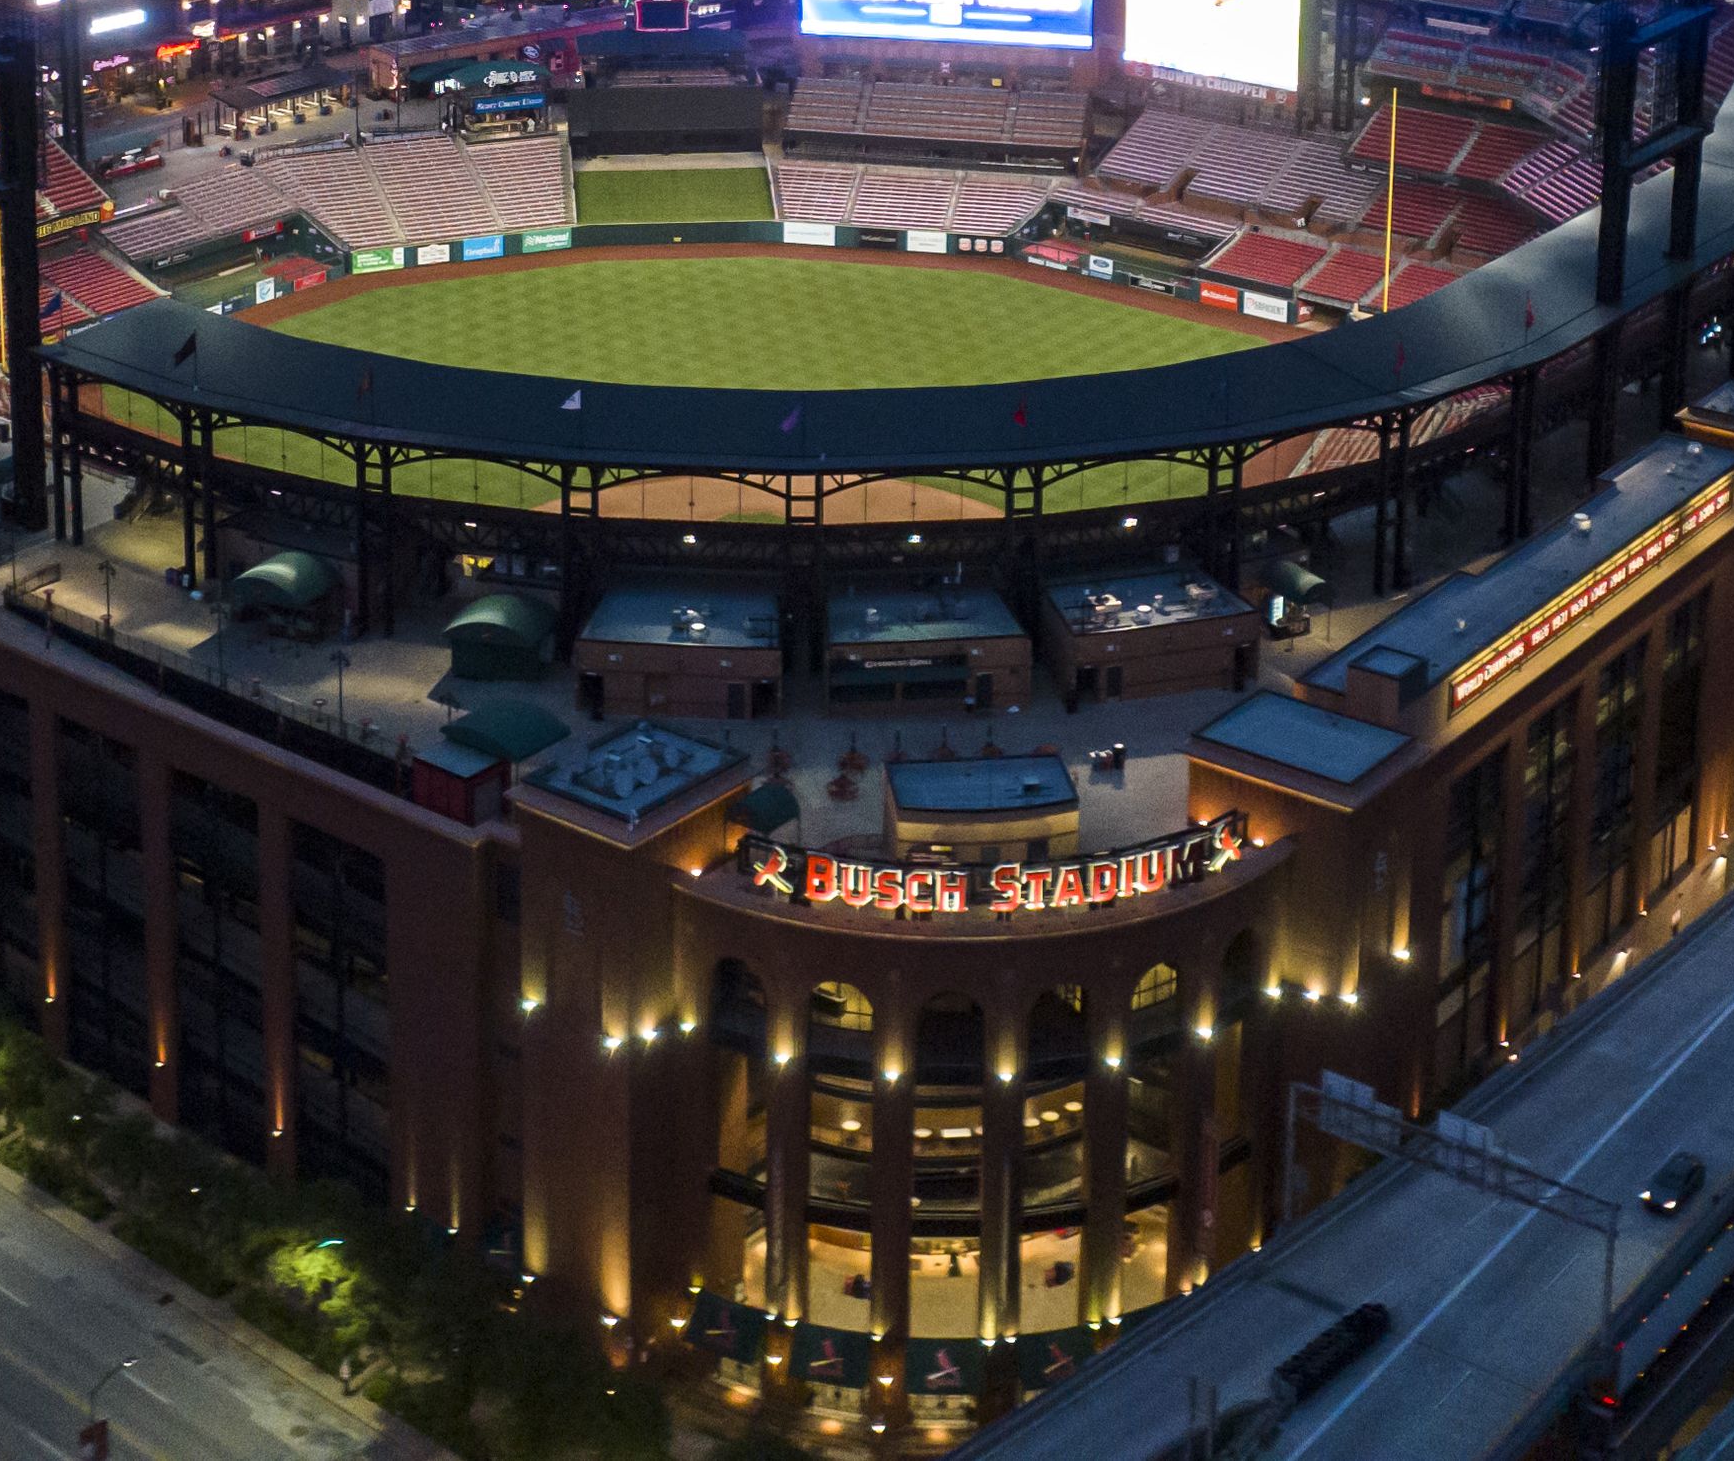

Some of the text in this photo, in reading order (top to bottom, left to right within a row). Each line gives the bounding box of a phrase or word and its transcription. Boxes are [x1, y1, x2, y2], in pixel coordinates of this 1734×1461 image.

[1151, 67, 1194, 87] BROWN
[805, 838, 1205, 913] BUSCH STADIUM
